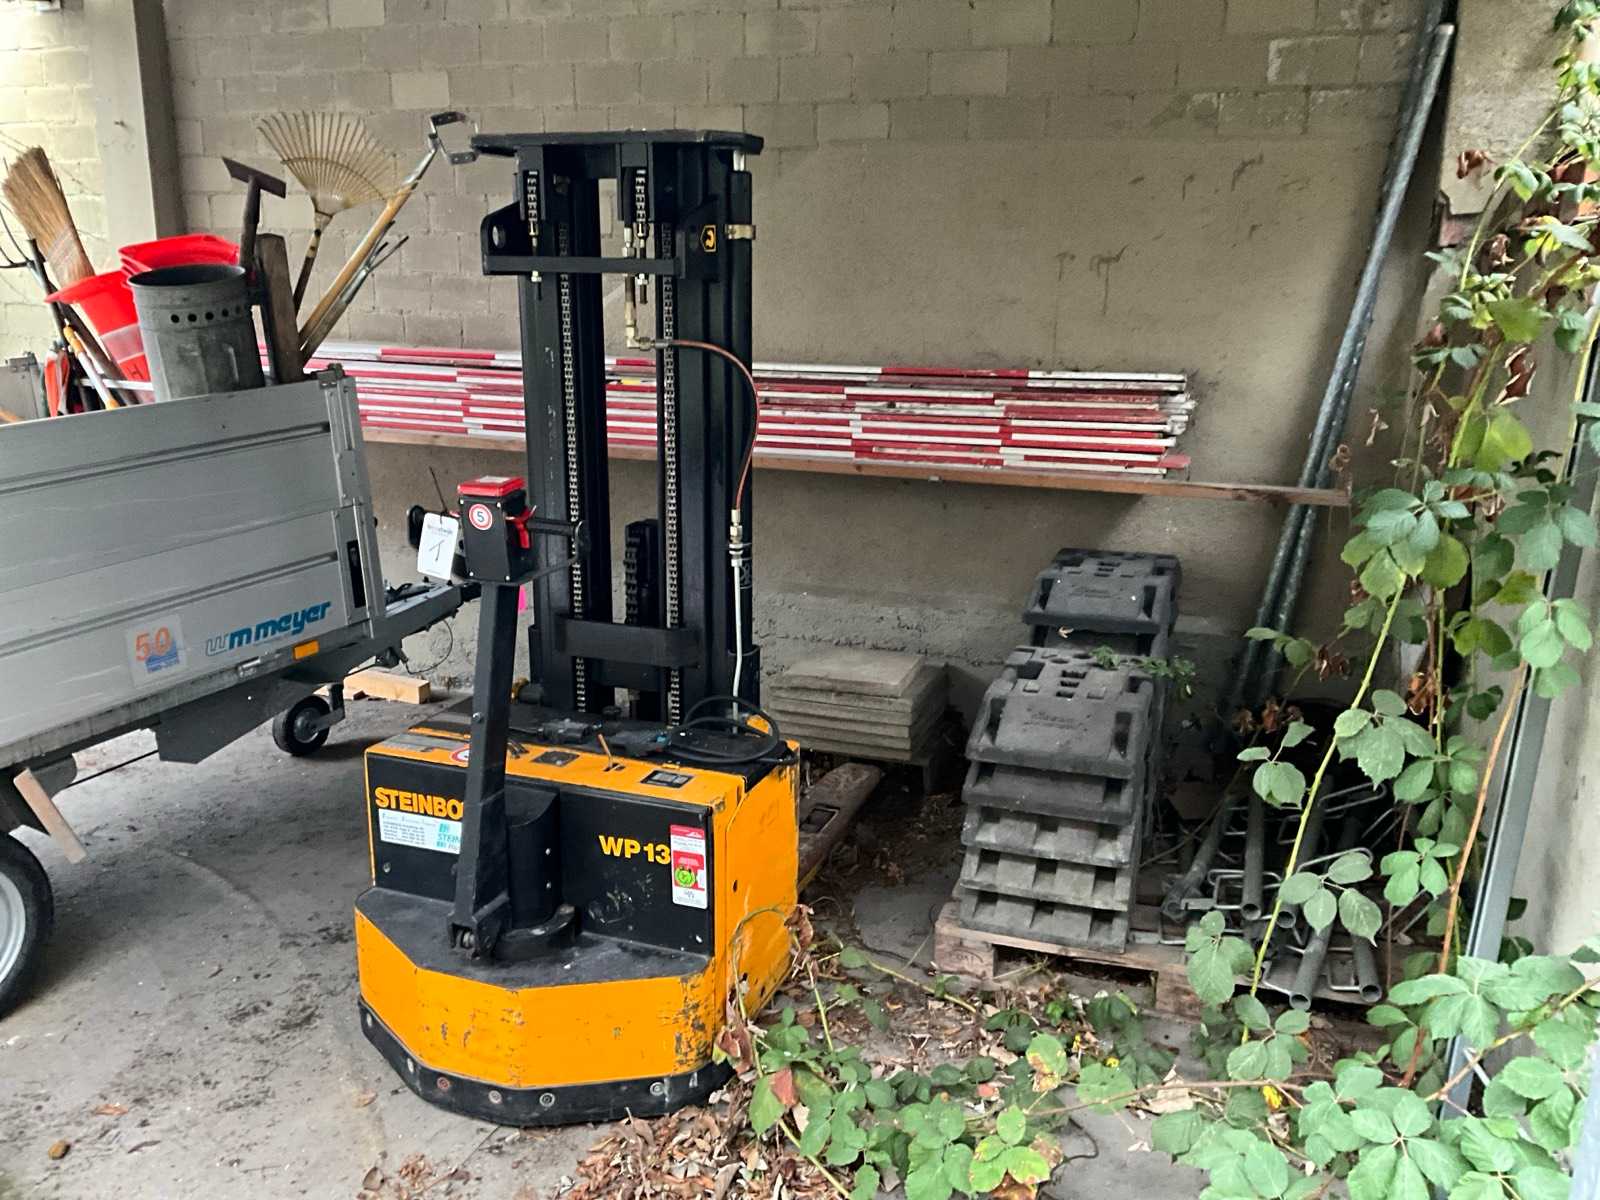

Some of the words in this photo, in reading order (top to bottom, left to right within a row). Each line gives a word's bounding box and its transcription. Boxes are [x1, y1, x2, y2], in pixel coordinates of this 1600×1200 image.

[476, 511, 485, 522] 5
[255, 602, 331, 635] meyer
[374, 786, 464, 820] STEINBO
[598, 834, 641, 859] WP
[643, 843, 671, 865] 13
